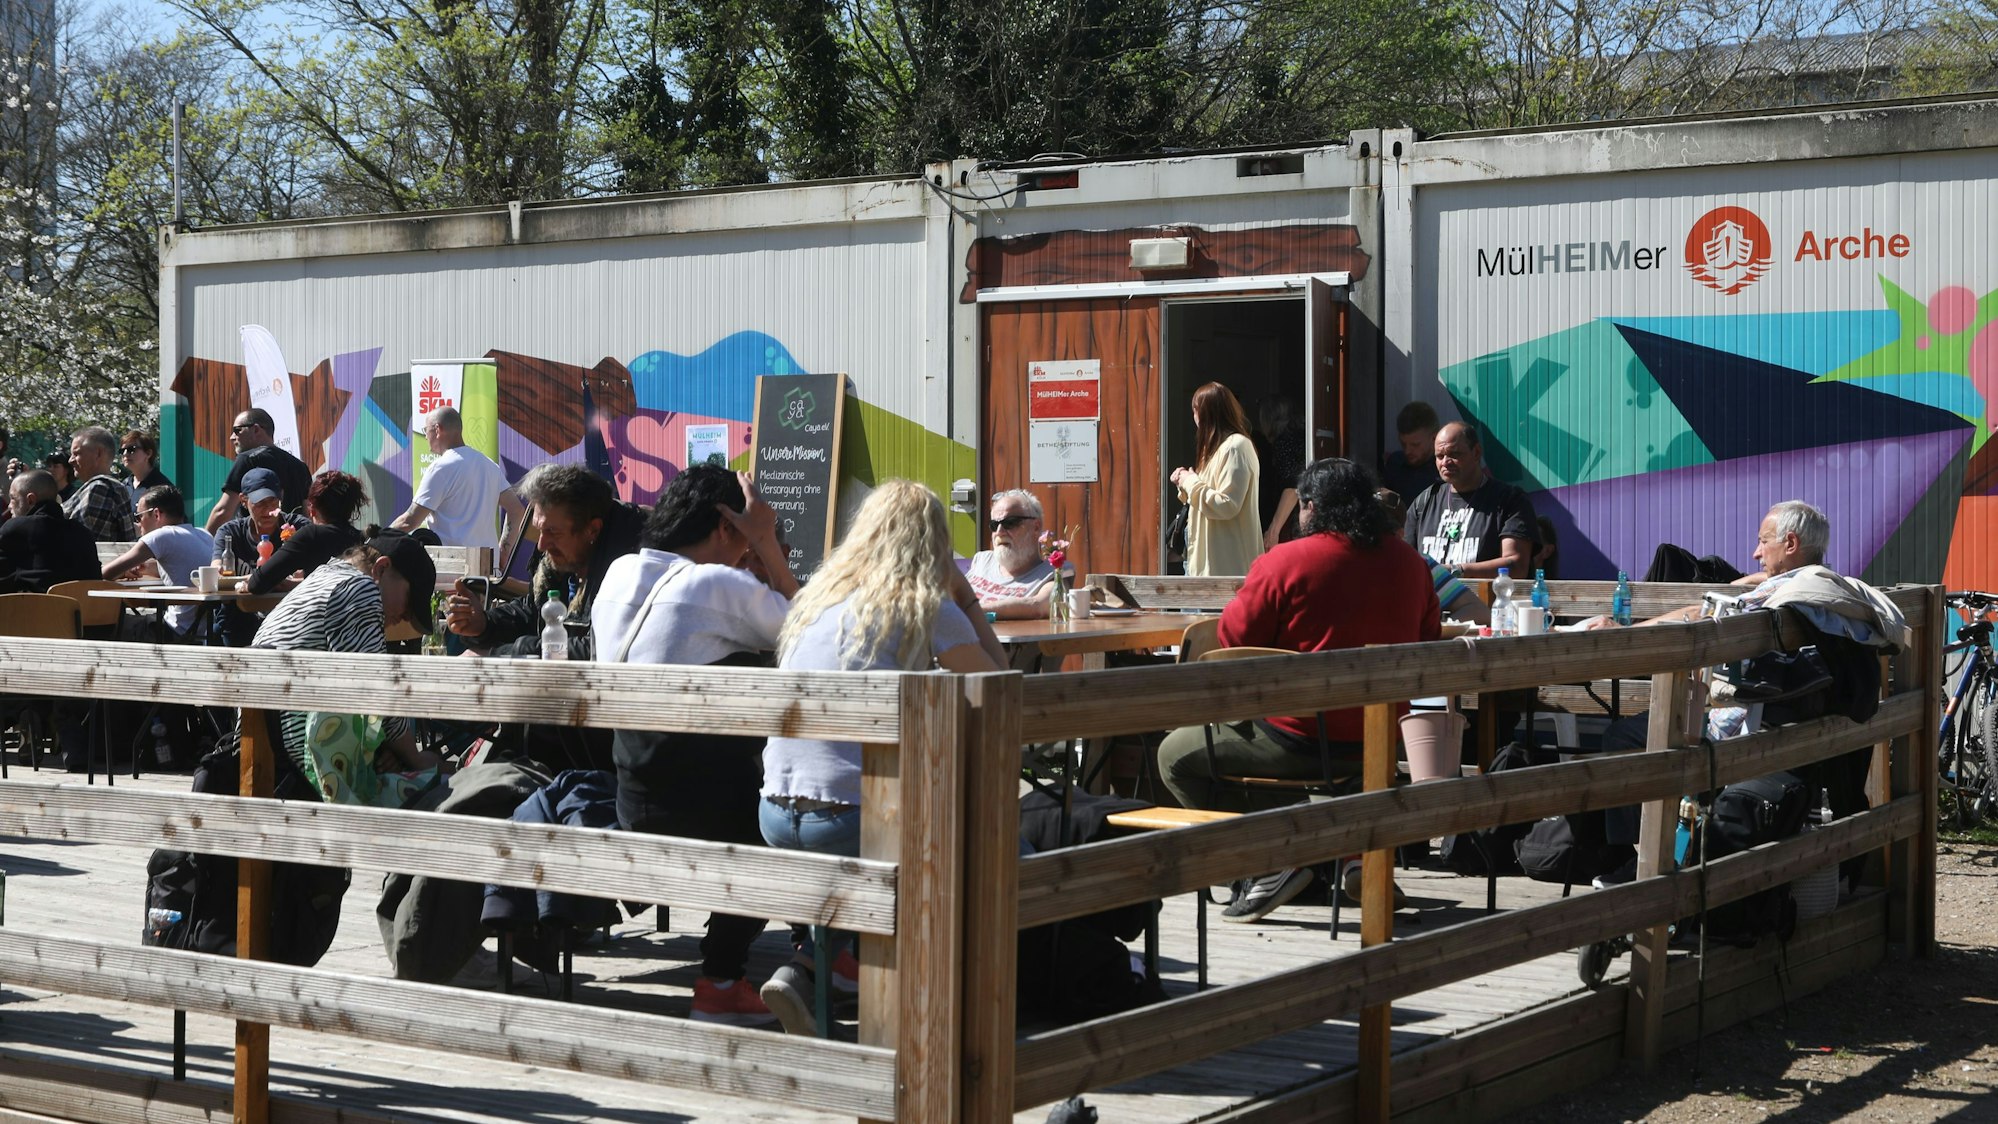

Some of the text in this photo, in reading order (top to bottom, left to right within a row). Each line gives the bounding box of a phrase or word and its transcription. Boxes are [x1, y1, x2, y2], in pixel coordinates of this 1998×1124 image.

[1477, 228, 1911, 277] MülHEIMer Arche
[804, 424, 821, 435] Caya
[420, 453, 441, 463] SACH
[792, 445, 826, 462] Mission
[760, 469, 805, 480] Medizinische
[760, 483, 821, 498] Versorgung ohne
